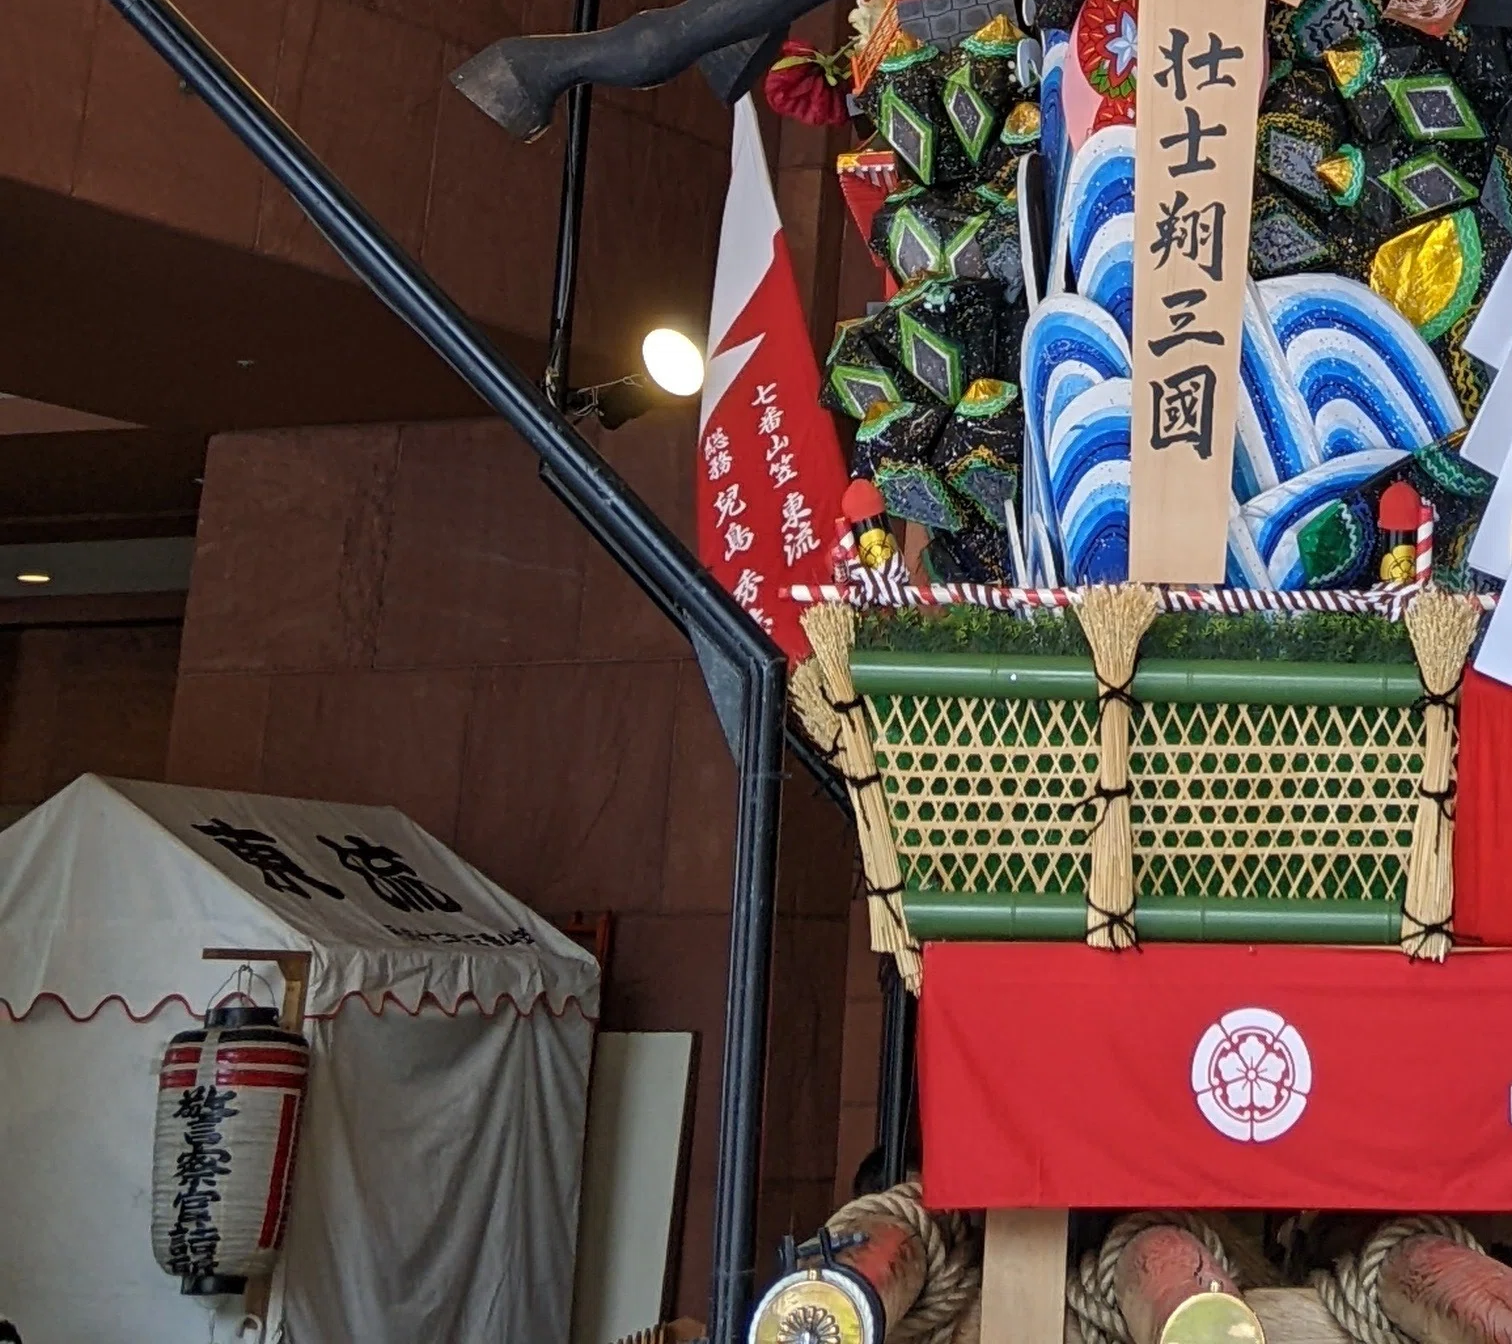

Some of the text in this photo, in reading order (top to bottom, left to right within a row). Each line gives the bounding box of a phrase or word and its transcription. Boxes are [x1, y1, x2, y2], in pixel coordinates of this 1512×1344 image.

[750, 382, 822, 567] 七番山笠 東流
[189, 817, 464, 913] 東流
